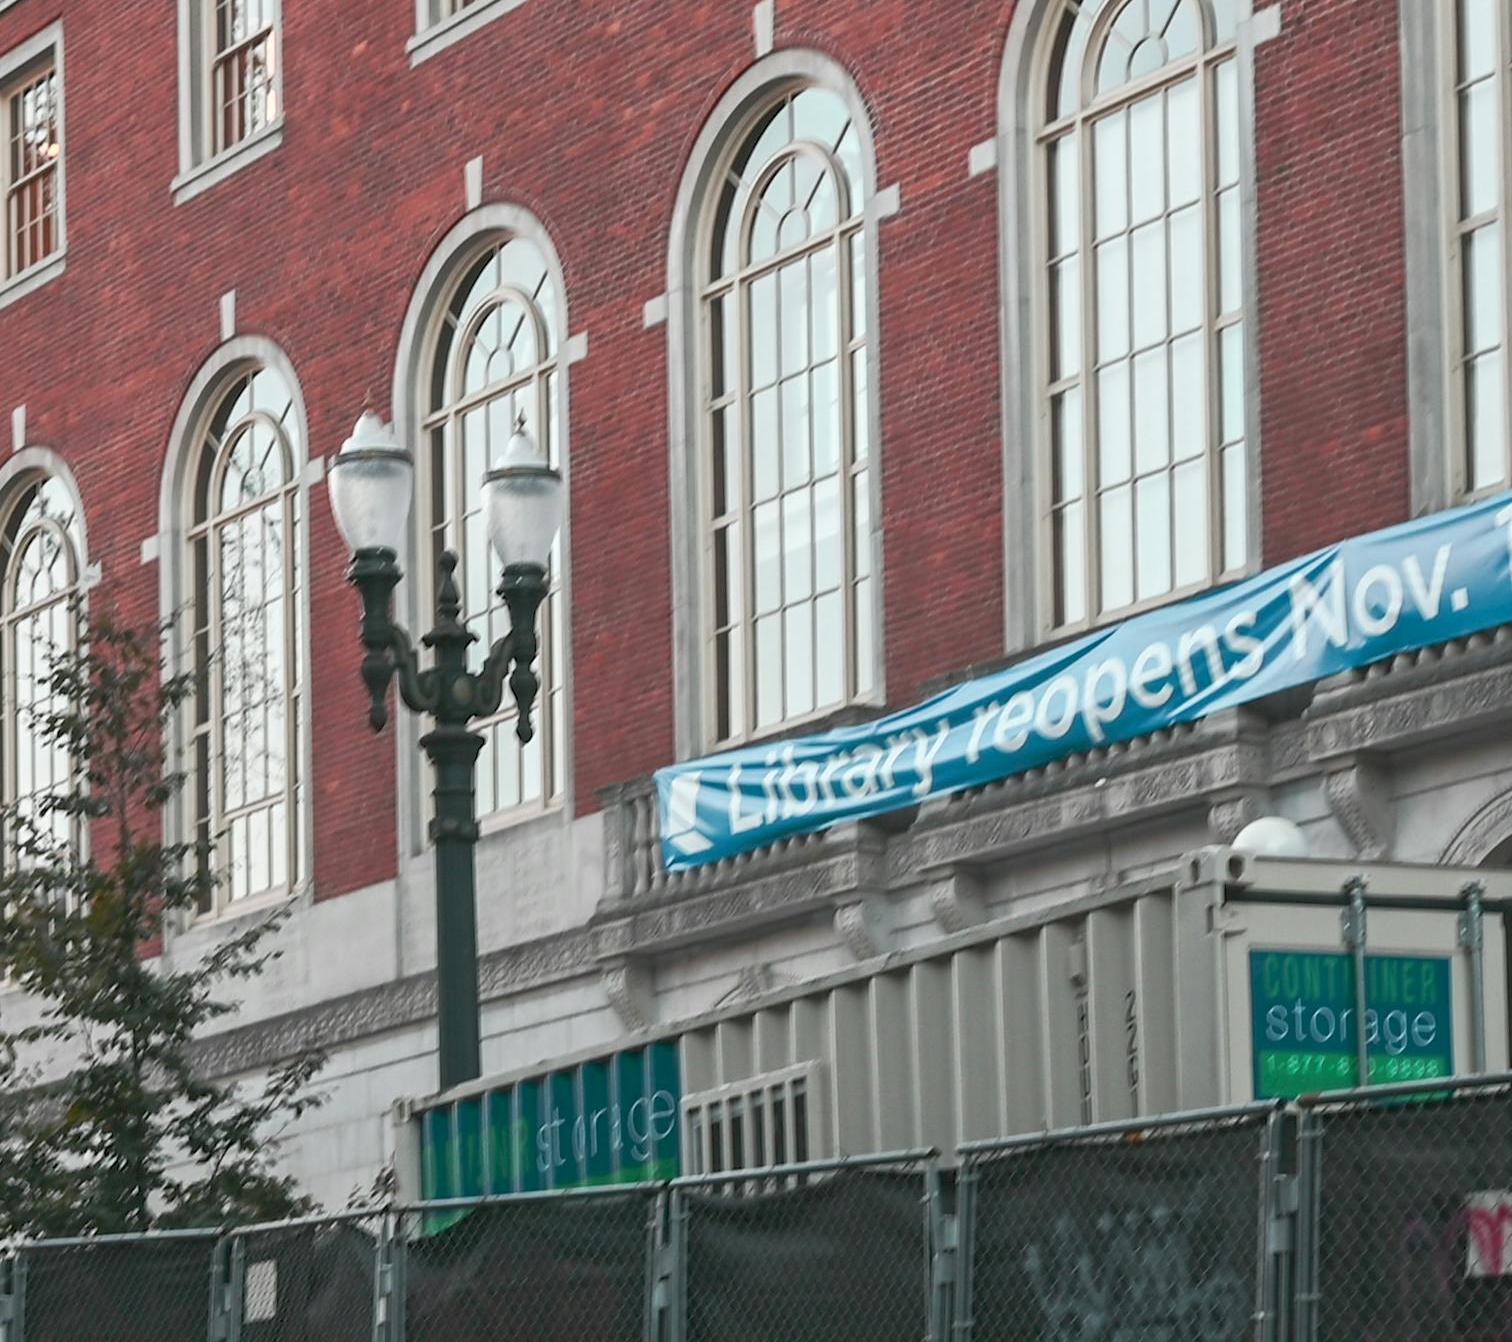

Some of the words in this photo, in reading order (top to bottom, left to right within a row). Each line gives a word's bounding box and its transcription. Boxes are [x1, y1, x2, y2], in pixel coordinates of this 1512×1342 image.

[726, 715, 955, 836] Library
[967, 607, 1265, 767] reopens
[1287, 541, 1472, 658] Nov.
